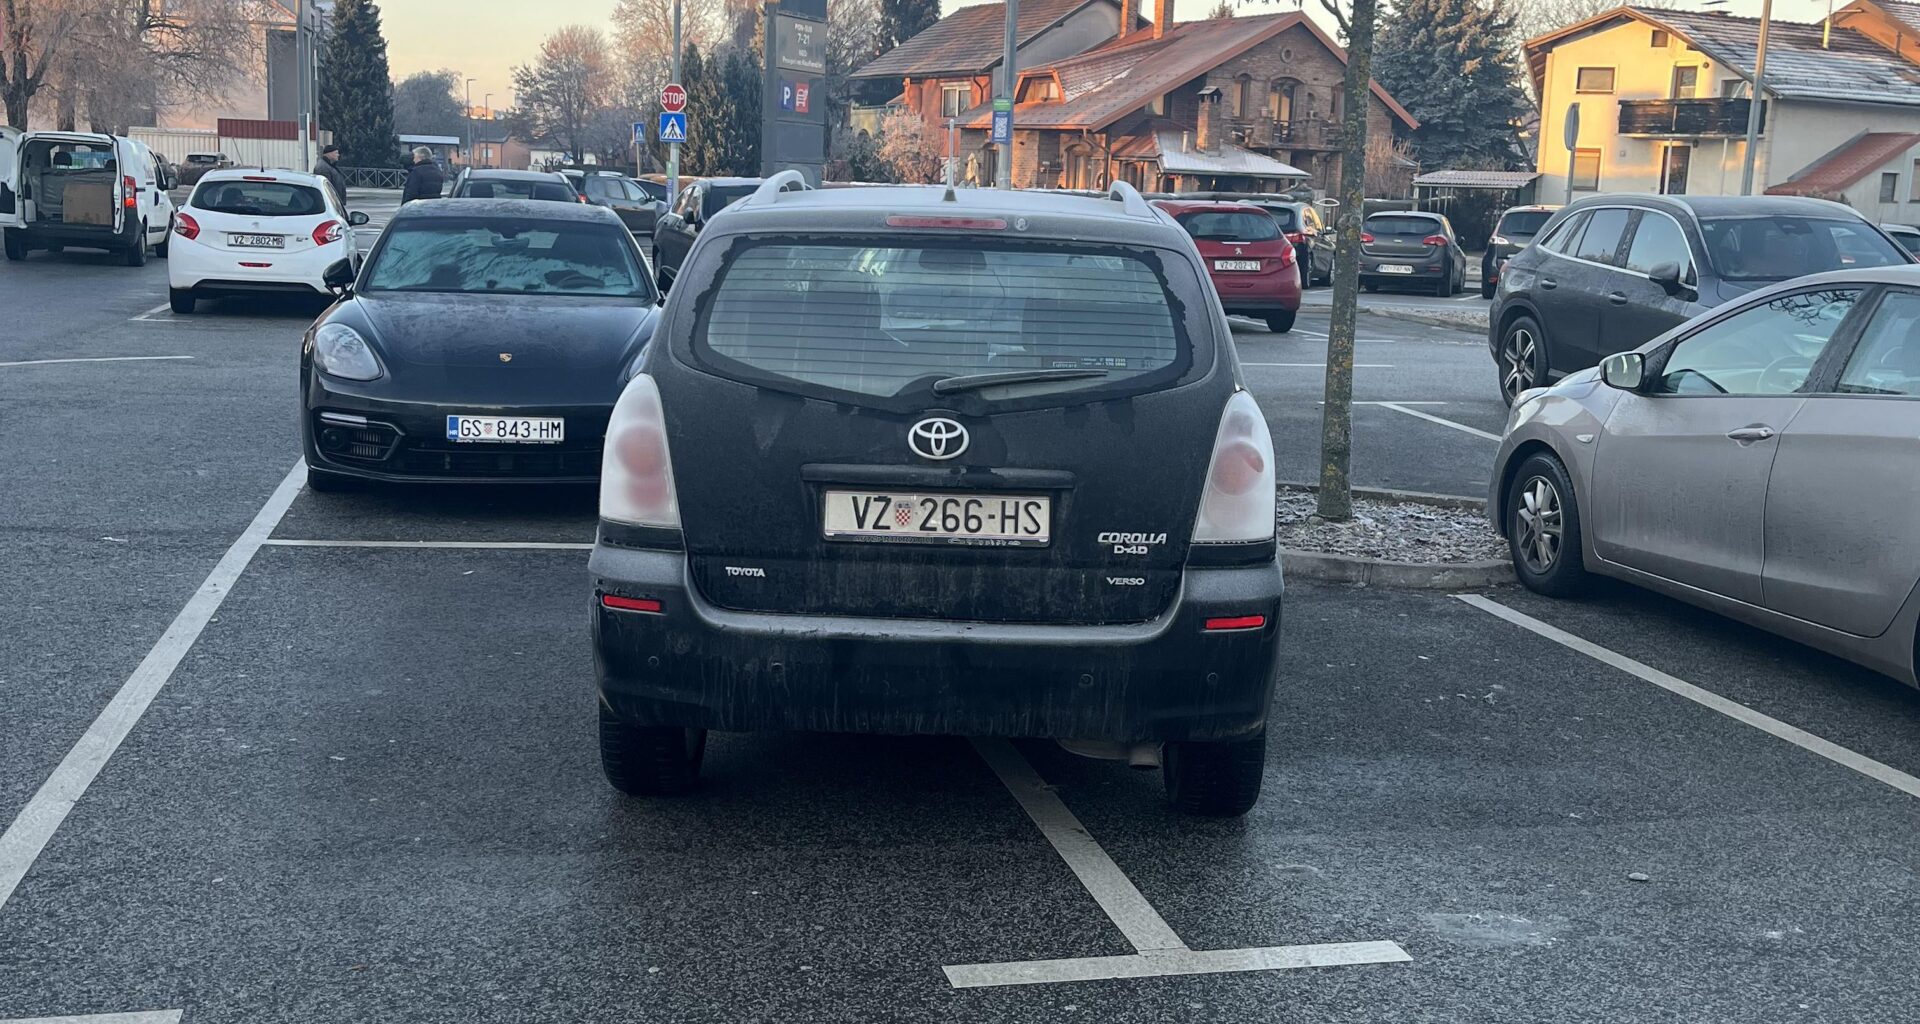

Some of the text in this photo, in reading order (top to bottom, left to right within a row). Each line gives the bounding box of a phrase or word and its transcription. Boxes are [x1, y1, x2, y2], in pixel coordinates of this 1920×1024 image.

[797, 32, 810, 45] 7-21
[662, 91, 685, 105] STOP
[783, 86, 791, 105] P
[461, 419, 560, 438] GS 843-HM
[919, 497, 1042, 535] 266-HS
[1097, 532, 1167, 545] COROLLA
[1113, 545, 1148, 555] D-4D
[725, 566, 766, 578] TOYOTA
[1106, 577, 1145, 586] VERSO
